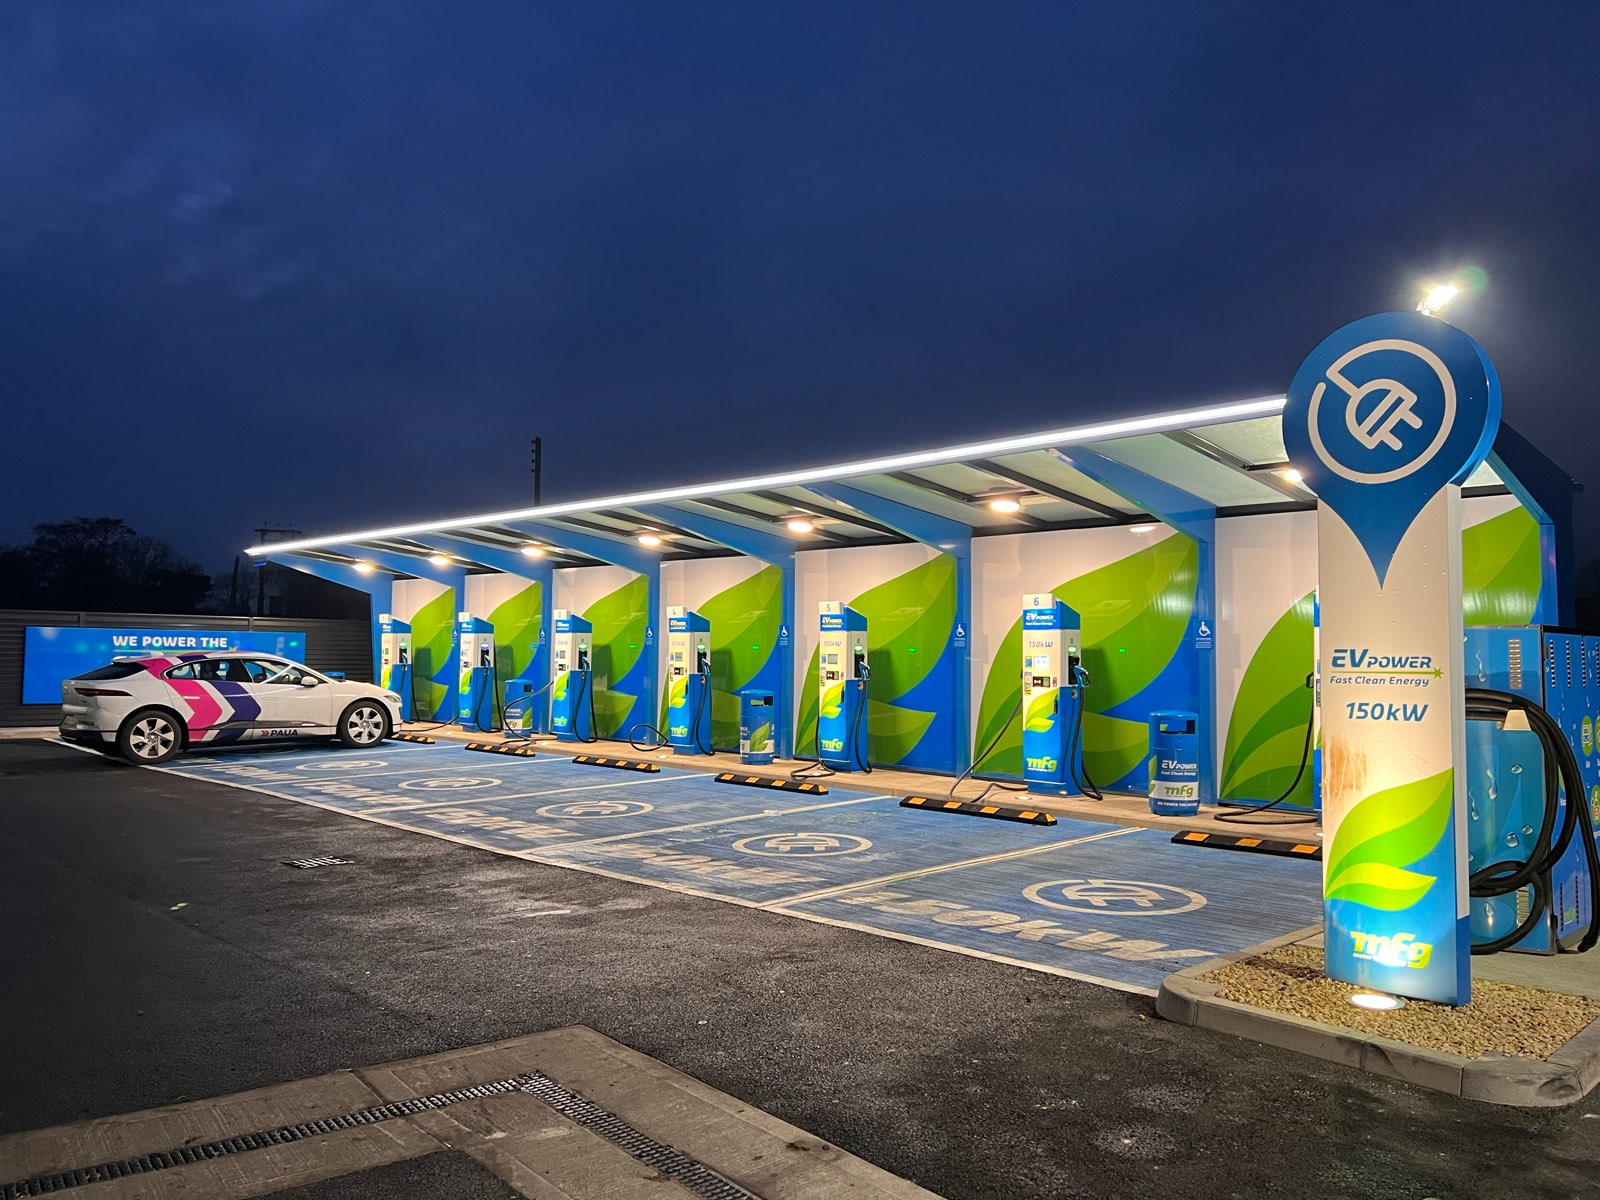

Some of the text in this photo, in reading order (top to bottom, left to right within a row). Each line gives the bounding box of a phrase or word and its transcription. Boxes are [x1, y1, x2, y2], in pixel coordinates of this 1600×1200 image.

[1033, 597, 1040, 606] 6
[112, 635, 228, 648] WE POWER THE
[1329, 675, 1430, 688] Fast Clean Energy
[1346, 702, 1429, 722] 150kW
[270, 729, 299, 737] PAUA
[1026, 756, 1057, 773] mfg
[1164, 784, 1194, 798] mfg
[1350, 930, 1433, 970] mfg
